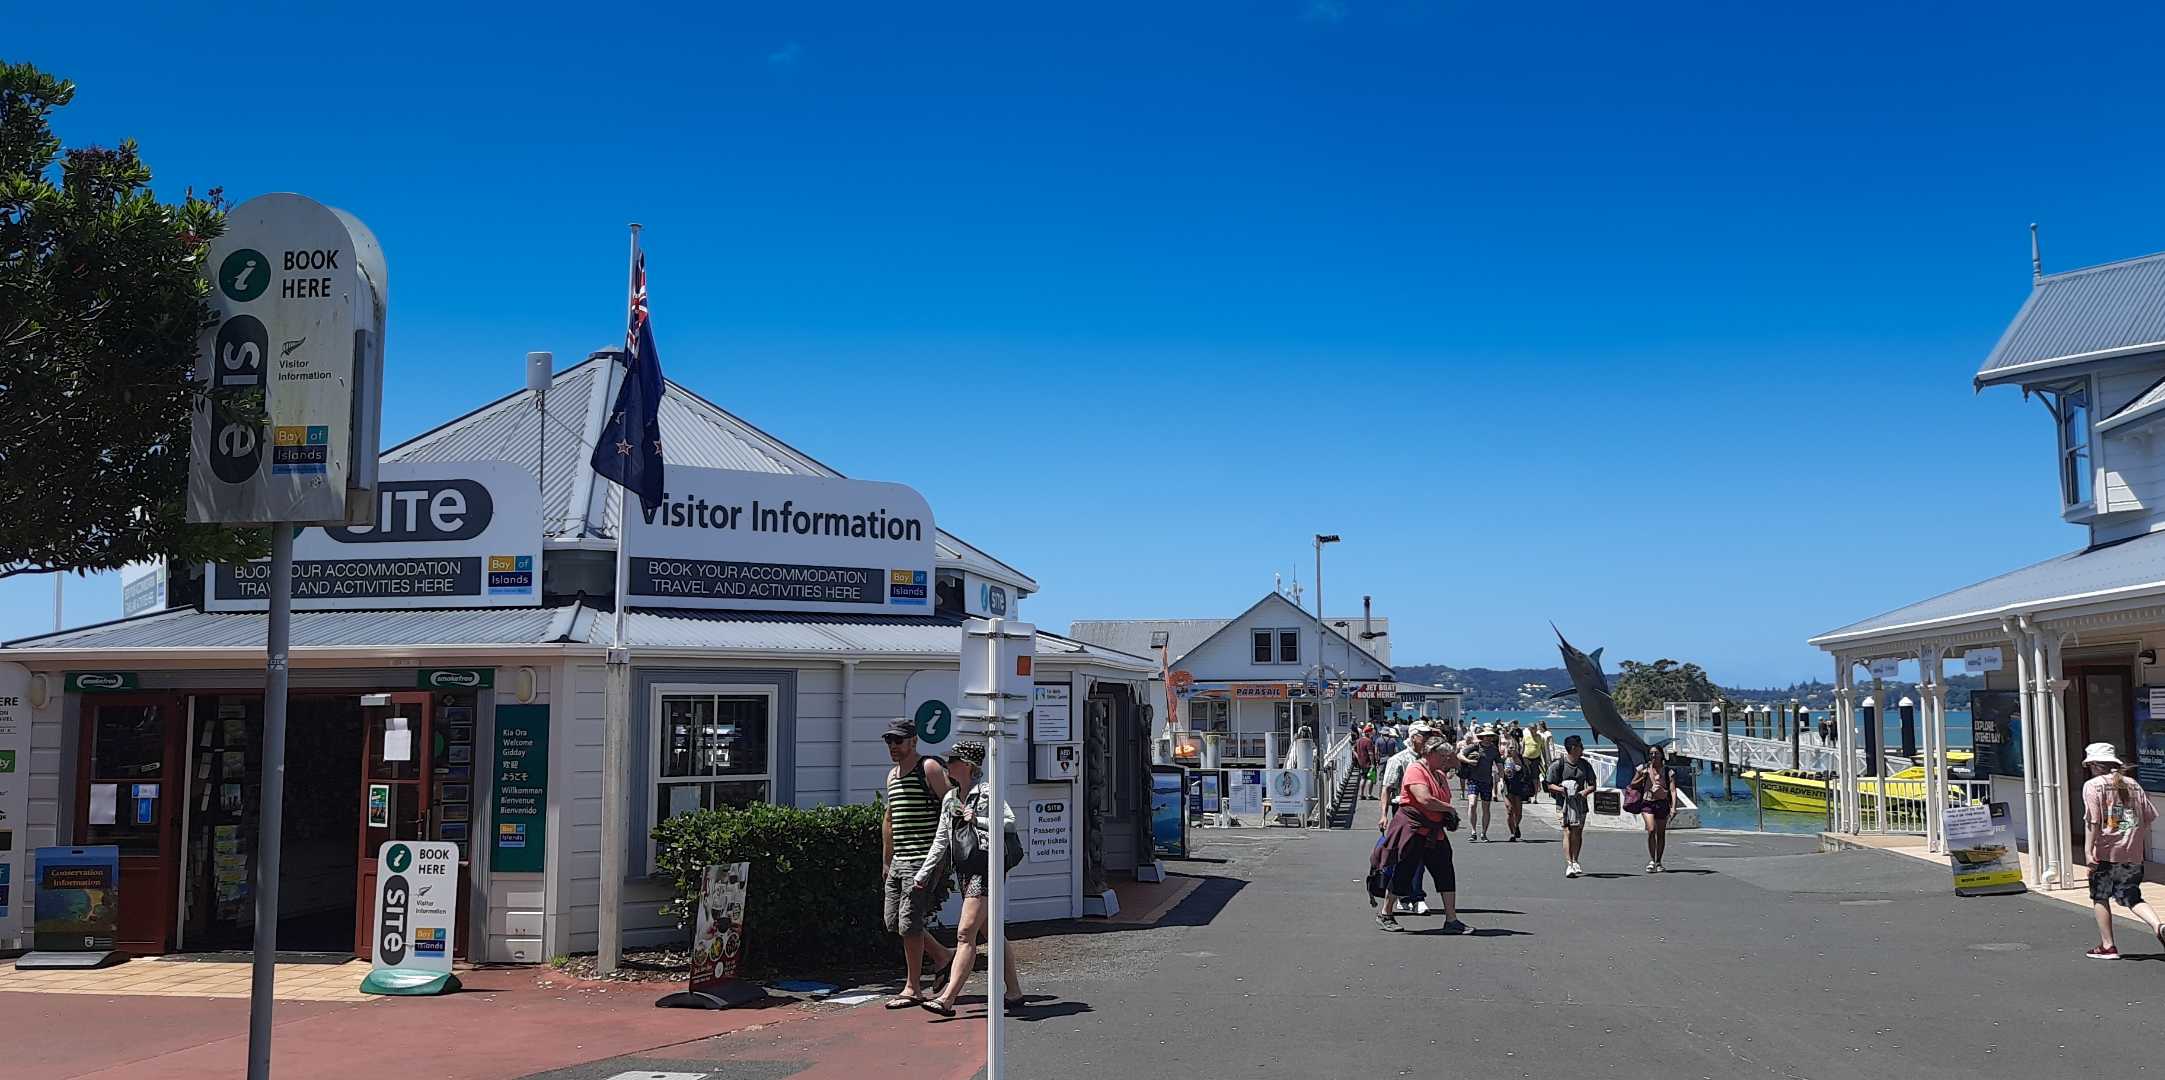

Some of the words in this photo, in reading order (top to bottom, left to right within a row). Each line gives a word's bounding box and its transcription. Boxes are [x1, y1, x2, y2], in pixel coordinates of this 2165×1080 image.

[283, 250, 339, 270] BOOK
[282, 277, 332, 299] HERE
[279, 360, 310, 369] Visitor
[278, 371, 332, 381] Information
[218, 341, 261, 458] SIe
[278, 431, 301, 442] Bay
[310, 431, 323, 441] of
[278, 450, 322, 460] Islands
[346, 488, 467, 534] ITe
[752, 500, 921, 541] Information
[291, 564, 322, 578] OUR
[325, 561, 461, 577] ACCOMMODATION
[492, 559, 511, 570] Bay
[518, 559, 529, 568] of
[648, 561, 693, 577] BOOK
[696, 564, 738, 579] YOUR
[740, 567, 867, 584] ACCOMMODATION
[894, 573, 910, 583] Bay
[915, 573, 925, 582] of
[492, 575, 529, 585] Islands
[298, 581, 331, 595] AND
[333, 579, 410, 595] ACTIVITIES
[414, 578, 454, 592] HERE
[652, 578, 710, 594] TRAVEL
[713, 581, 746, 596] AND
[748, 583, 822, 599] ACTIVITIES
[825, 586, 861, 600] HERE
[893, 587, 925, 596] Islands
[1236, 687, 1281, 697] PARASAIL
[502, 748, 526, 758] Gidday
[501, 772, 529, 781] ようこそ
[501, 786, 543, 795] Willkommen
[1761, 782, 1789, 793] OCEAN
[500, 796, 535, 805] Bienvenue
[500, 806, 537, 815] Bienvenido
[419, 848, 450, 860] BOOK
[51, 869, 104, 877] Conservation
[418, 864, 446, 875] HERE
[53, 879, 101, 887] Information
[383, 888, 406, 953] SITe
